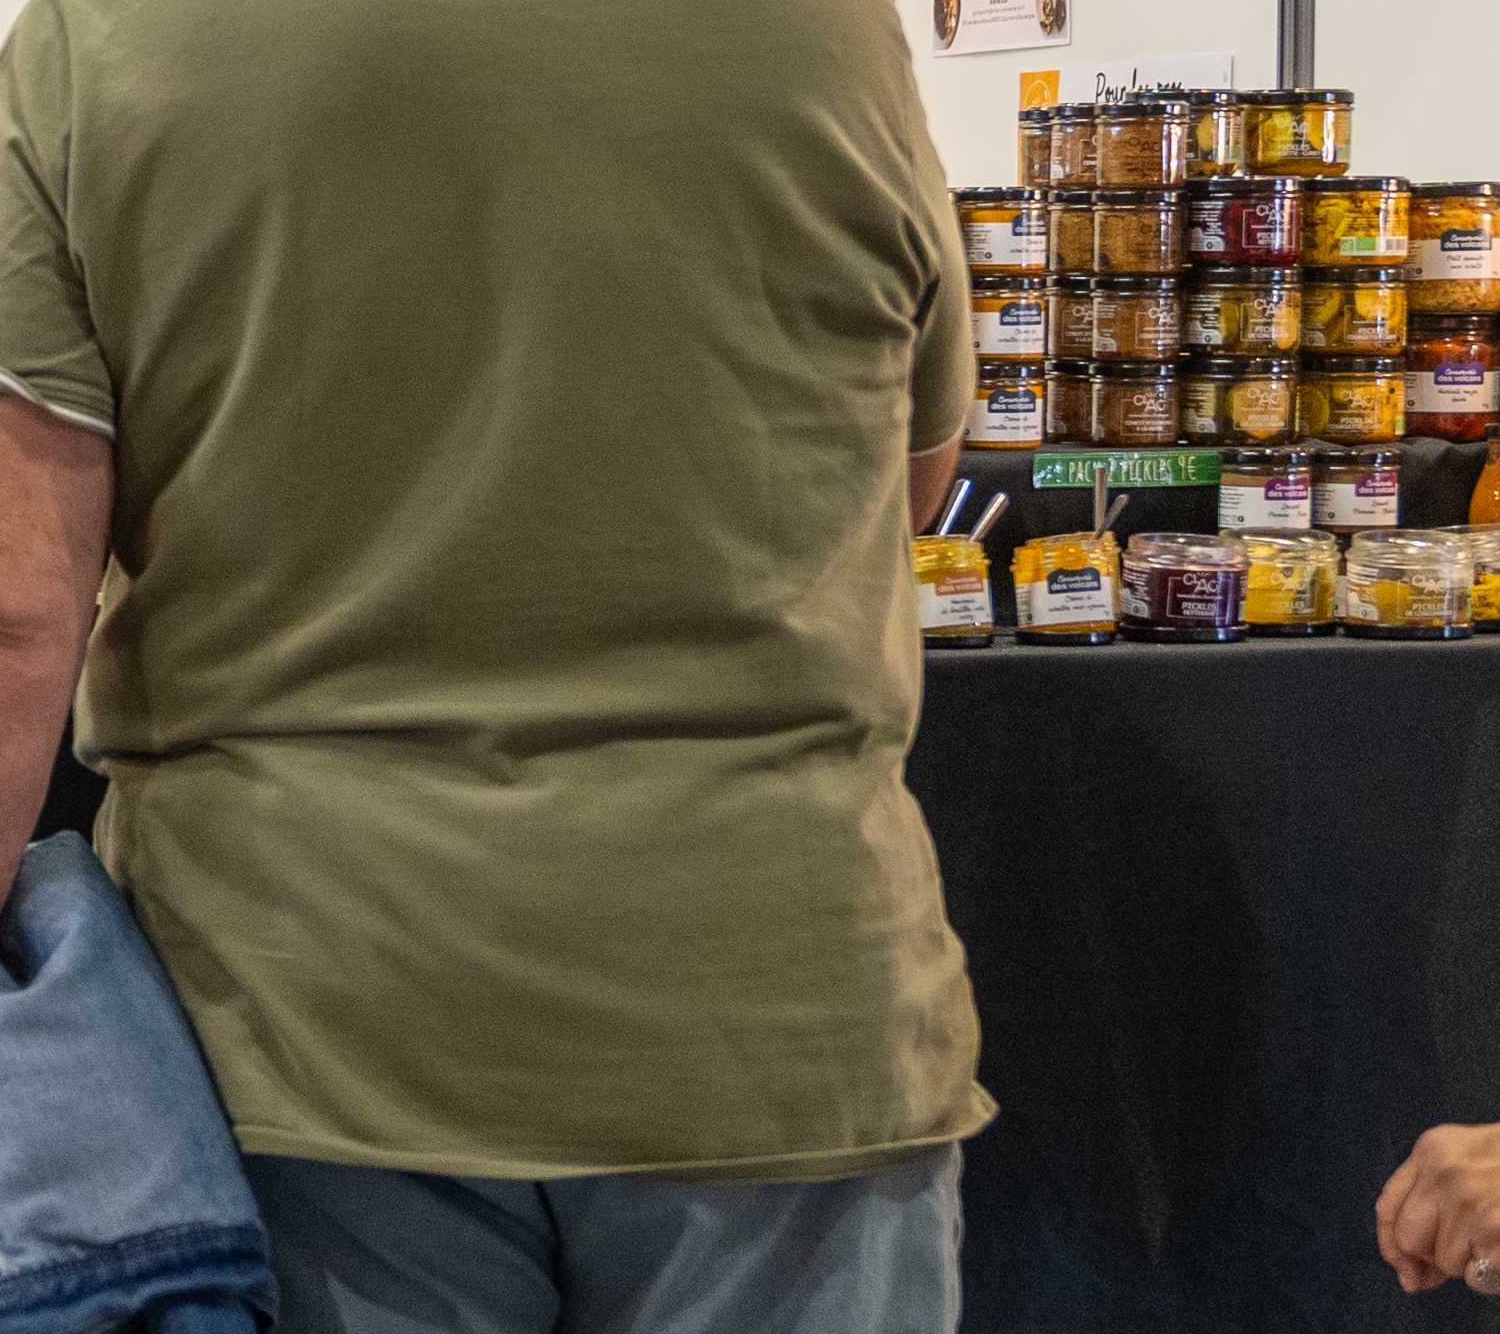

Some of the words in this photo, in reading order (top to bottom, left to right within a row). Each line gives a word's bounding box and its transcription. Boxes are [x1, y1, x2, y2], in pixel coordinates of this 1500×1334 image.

[1069, 460, 1101, 484] PAC
[1121, 459, 1173, 482] PICKLES
[1177, 455, 1198, 482] 9€
